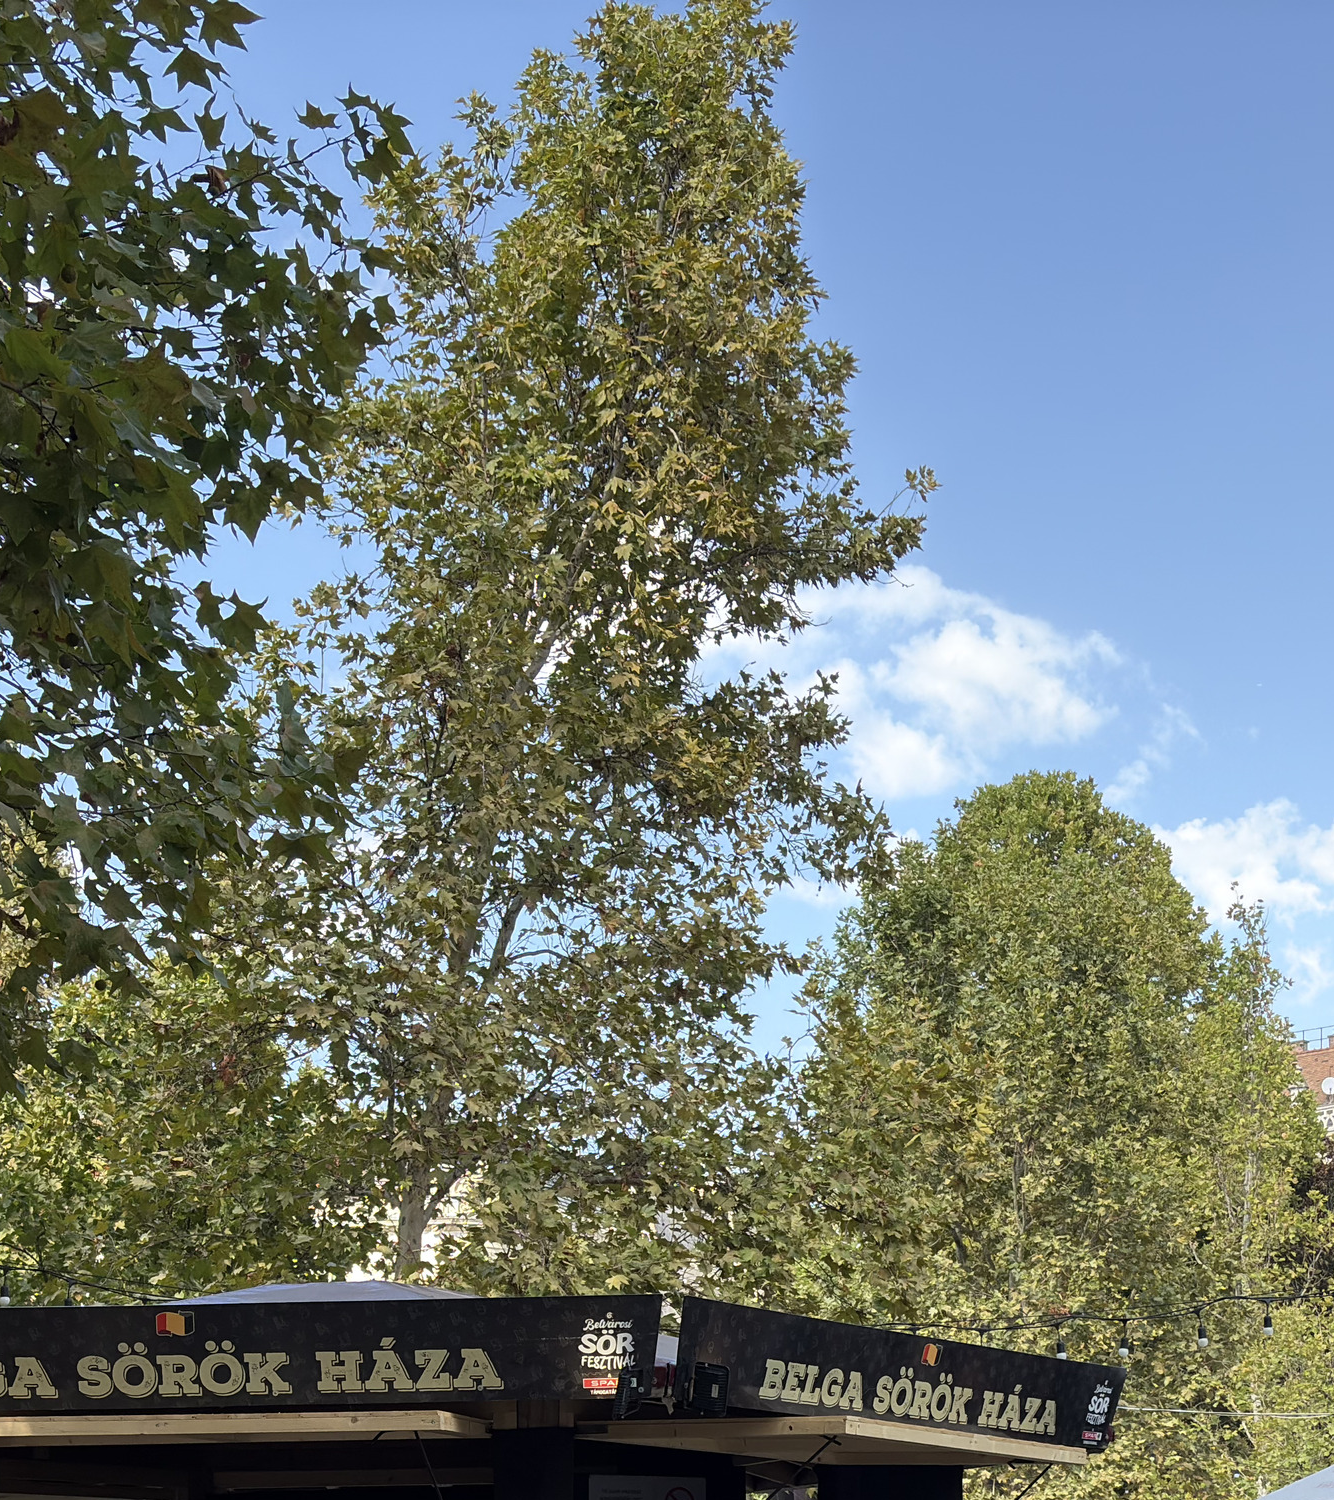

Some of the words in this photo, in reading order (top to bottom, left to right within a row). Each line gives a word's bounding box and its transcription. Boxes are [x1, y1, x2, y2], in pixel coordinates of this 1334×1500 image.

[582, 1318, 633, 1331] Belvárosi
[77, 1341, 292, 1400] SÖRÖK
[315, 1337, 505, 1396] HÁZA
[581, 1353, 636, 1370] FESZTIVÁL
[590, 1379, 619, 1387] SPA
[758, 1356, 864, 1412] BELGA
[873, 1366, 971, 1424] SÖRÖK
[978, 1385, 1059, 1437] HÁZA
